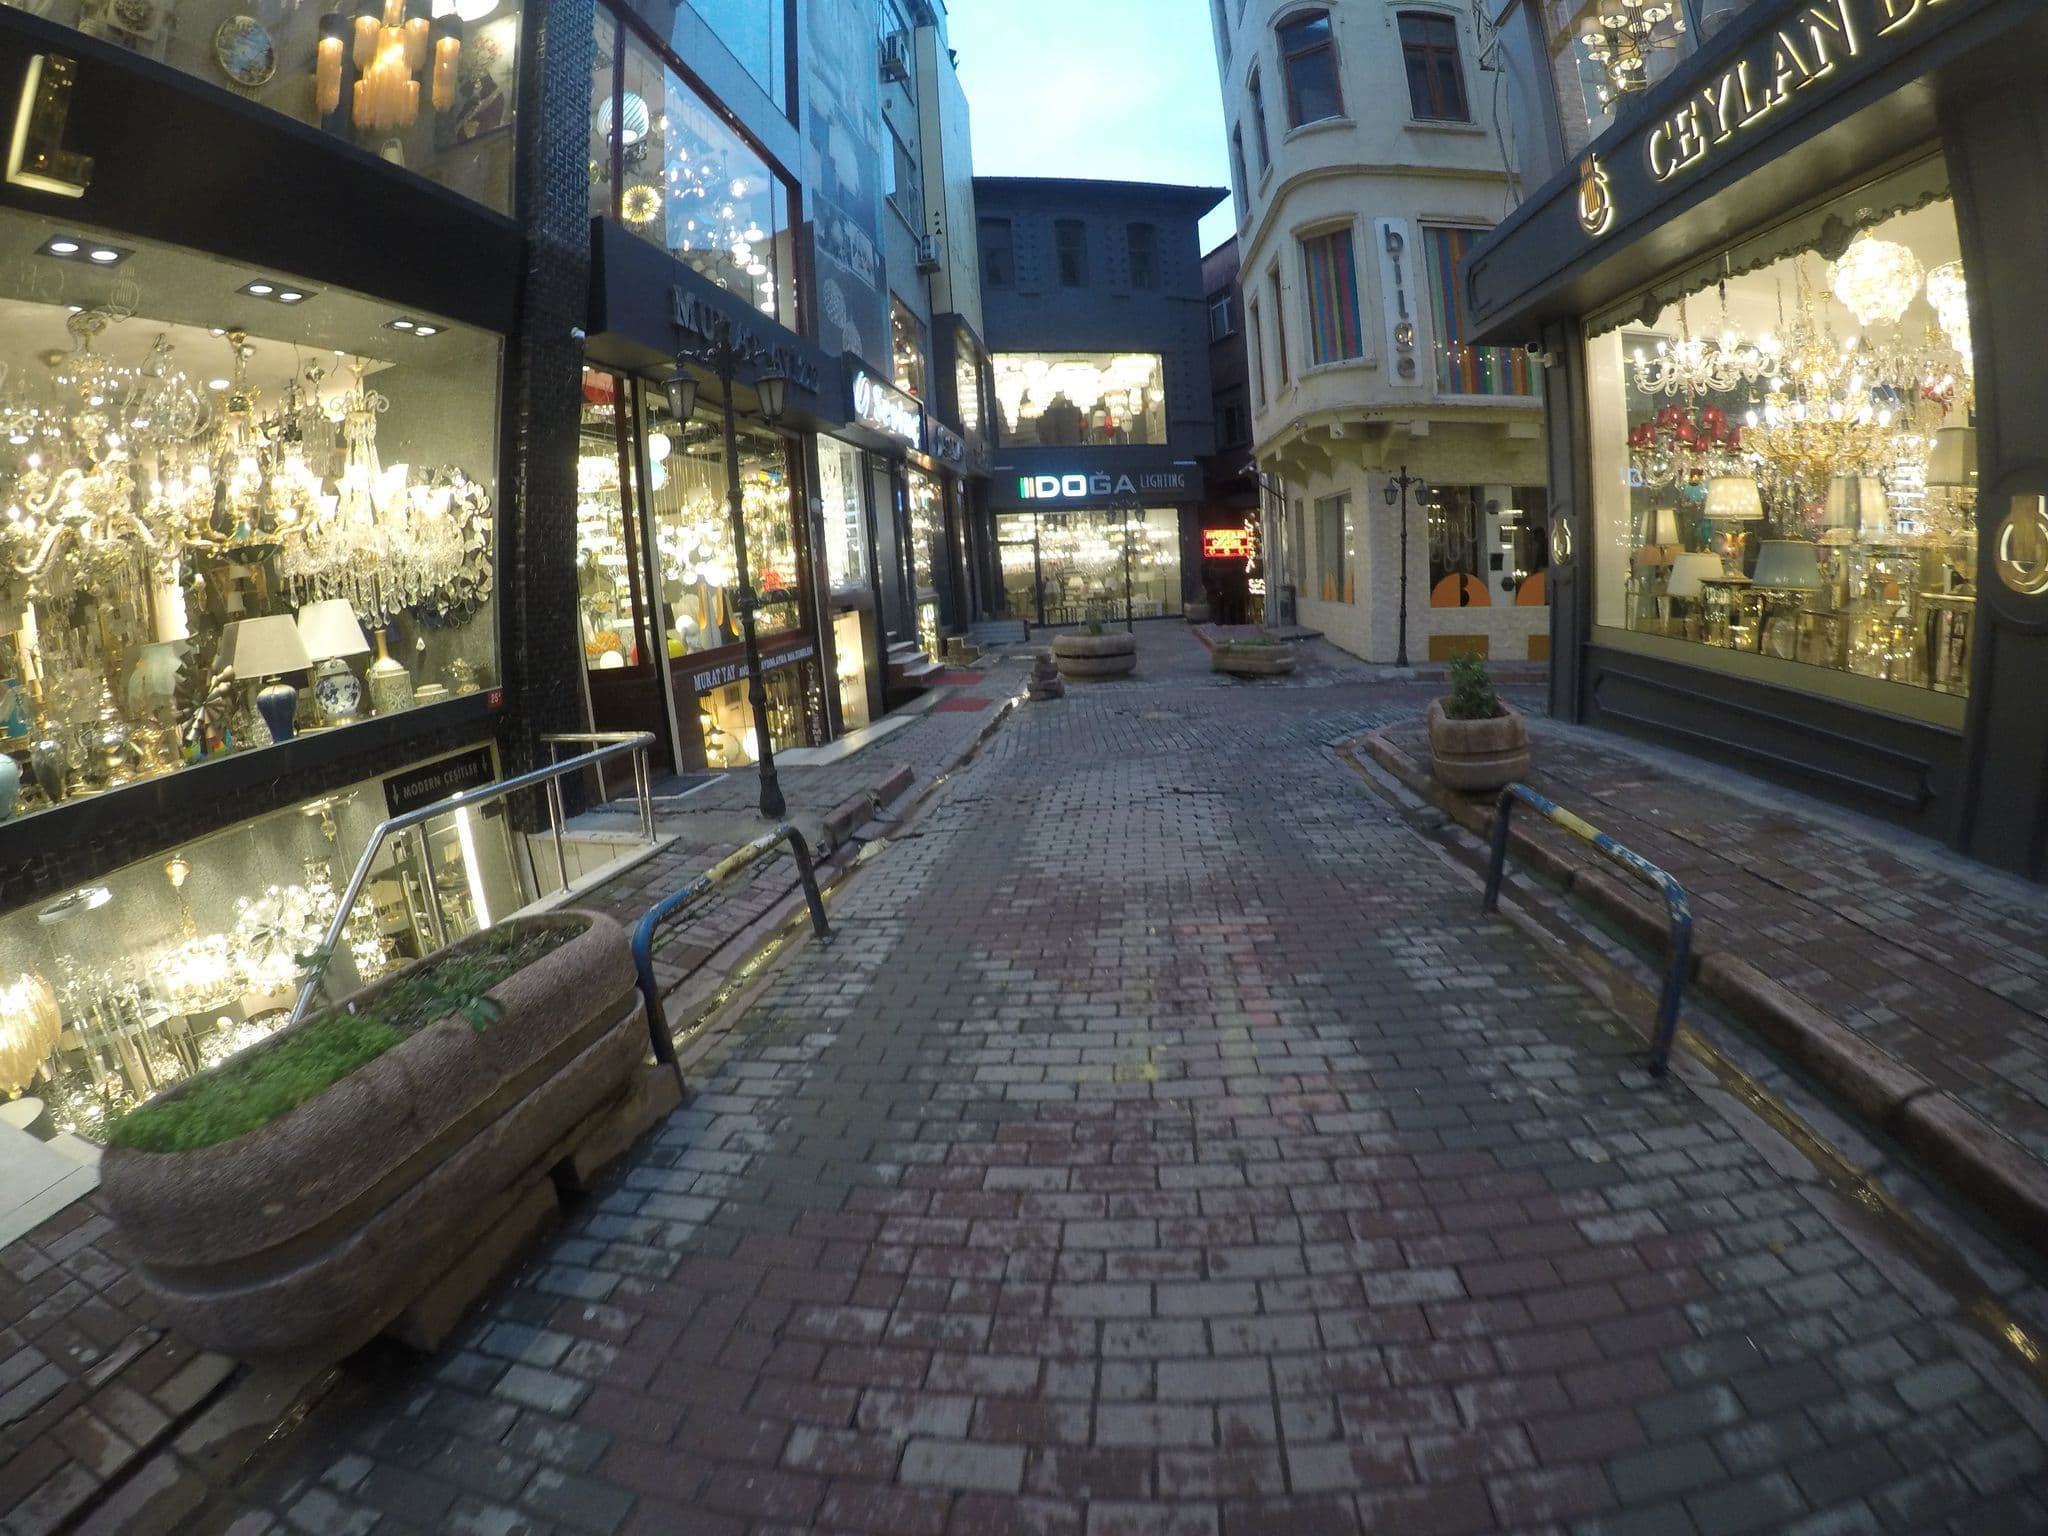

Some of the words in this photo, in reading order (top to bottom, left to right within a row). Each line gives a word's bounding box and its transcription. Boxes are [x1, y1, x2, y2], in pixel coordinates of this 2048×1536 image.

[1643, 0, 1858, 181] CEYLAN
[1384, 223, 1416, 379] bilge
[1035, 470, 1137, 498] DOĞA
[1140, 473, 1185, 489] LIGHTING
[693, 668, 721, 692] MURAT
[721, 664, 735, 682] YAY
[403, 775, 441, 798] MODERN
